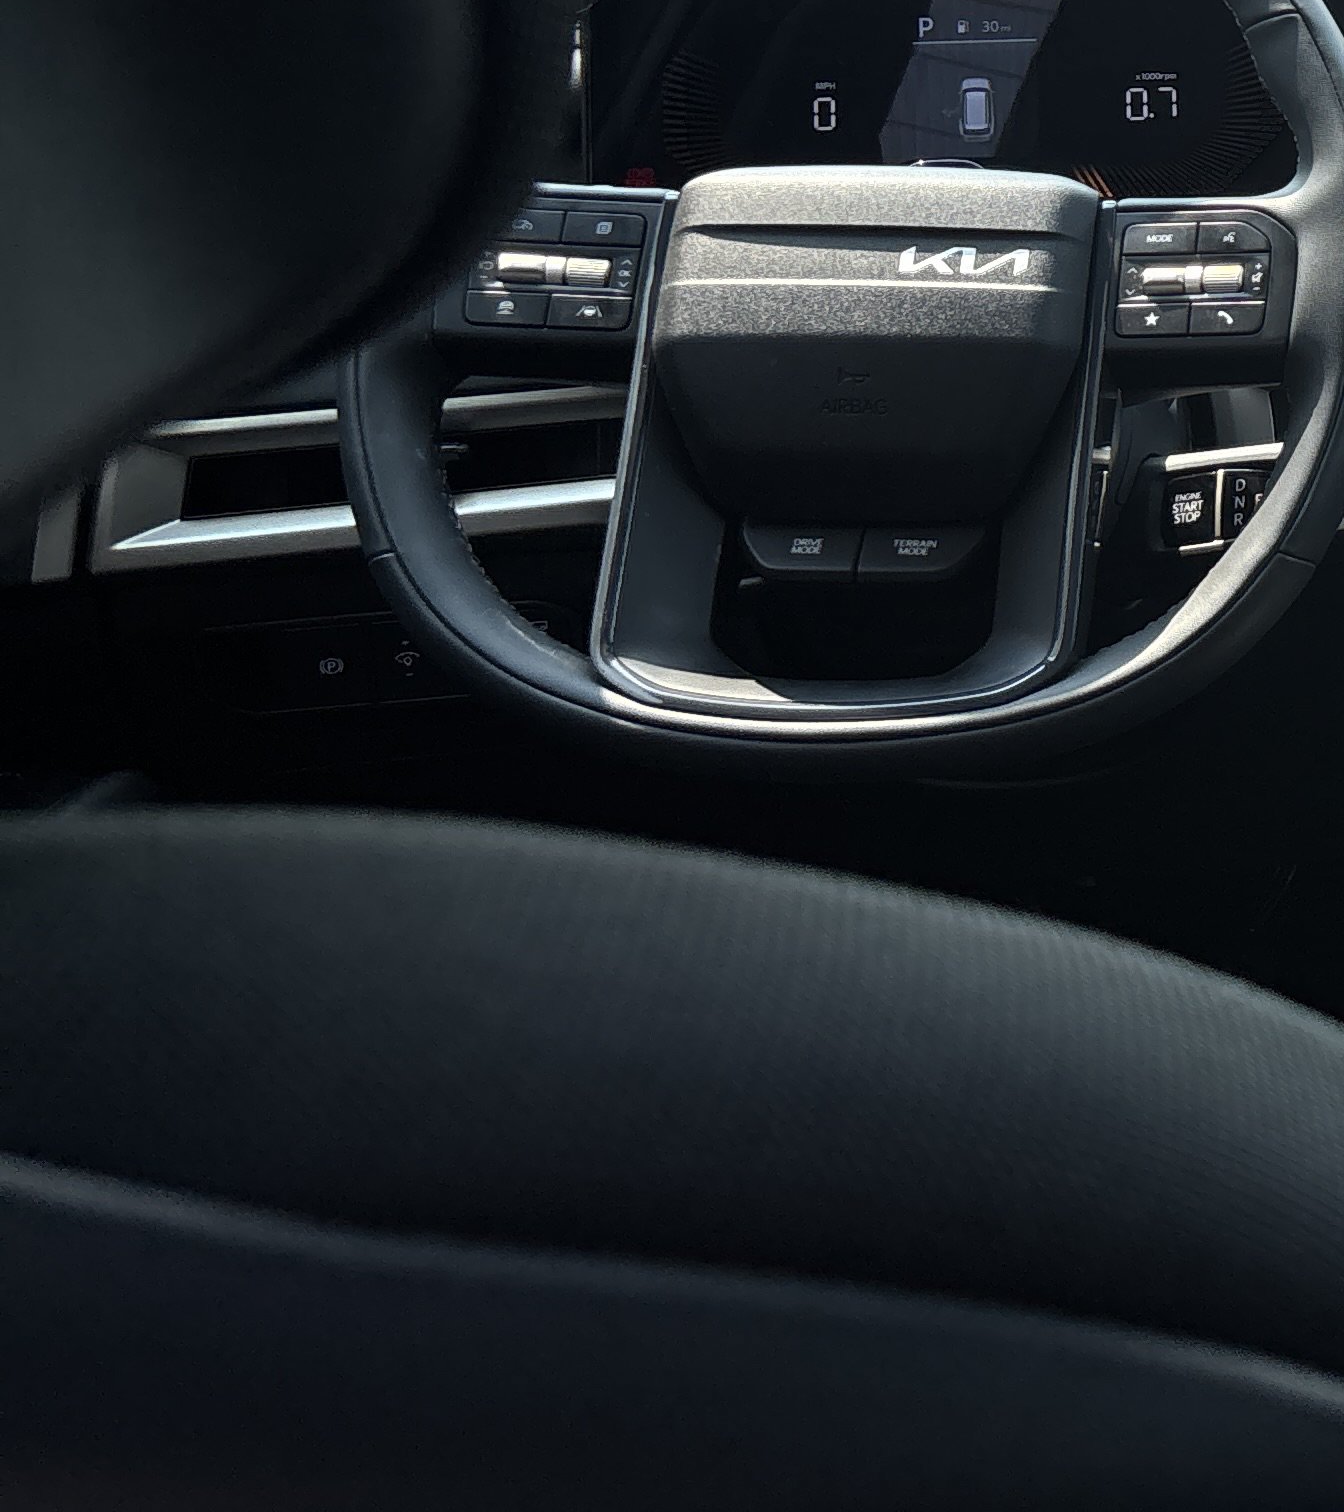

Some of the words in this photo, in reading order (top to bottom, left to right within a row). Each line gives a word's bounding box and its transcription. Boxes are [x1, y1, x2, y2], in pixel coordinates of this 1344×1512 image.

[918, 17, 935, 38] P
[1125, 86, 1178, 121] 0.7
[813, 96, 836, 131] 0
[1146, 233, 1174, 243] MODE
[898, 245, 1031, 277] KIA
[820, 397, 889, 416] AIRBAG
[1235, 479, 1246, 492] D
[1174, 491, 1203, 502] ENGINE
[1234, 495, 1245, 509] N
[1171, 500, 1204, 515] START
[1173, 511, 1201, 525] STOP
[1234, 513, 1244, 526] R
[793, 538, 824, 546] DRIVE
[893, 538, 937, 548] TERRAIN
[790, 546, 821, 554] MODE
[897, 547, 928, 556] MODE
